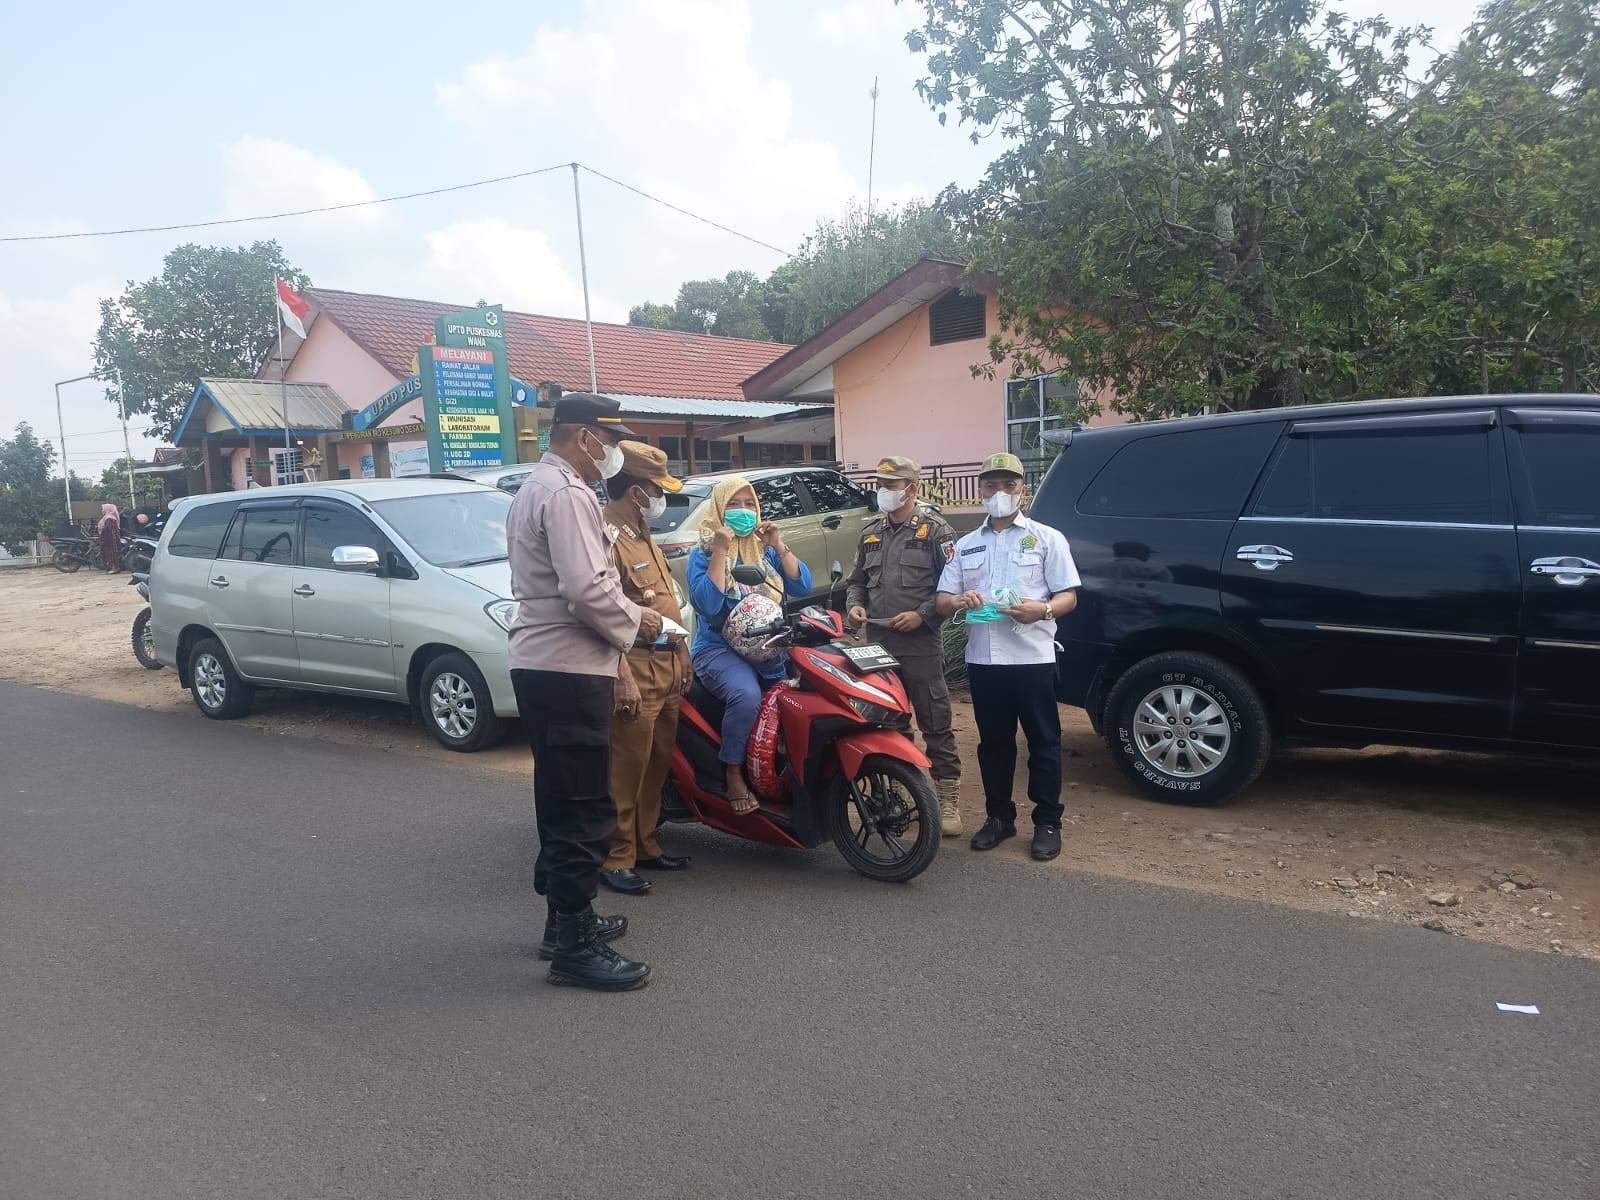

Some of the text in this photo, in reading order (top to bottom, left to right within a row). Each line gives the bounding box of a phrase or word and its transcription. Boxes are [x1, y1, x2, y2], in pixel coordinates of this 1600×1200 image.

[440, 348, 487, 361] MELAYANI
[462, 363, 480, 371] JALAN
[371, 390, 398, 415] UPTD
[445, 397, 457, 405] GIZI
[450, 450, 463, 458] USG
[463, 450, 471, 458] 2D
[783, 695, 803, 710] HONDA
[1162, 673, 1242, 732] GT RADIAL
[1134, 761, 1201, 791] SAVERO
